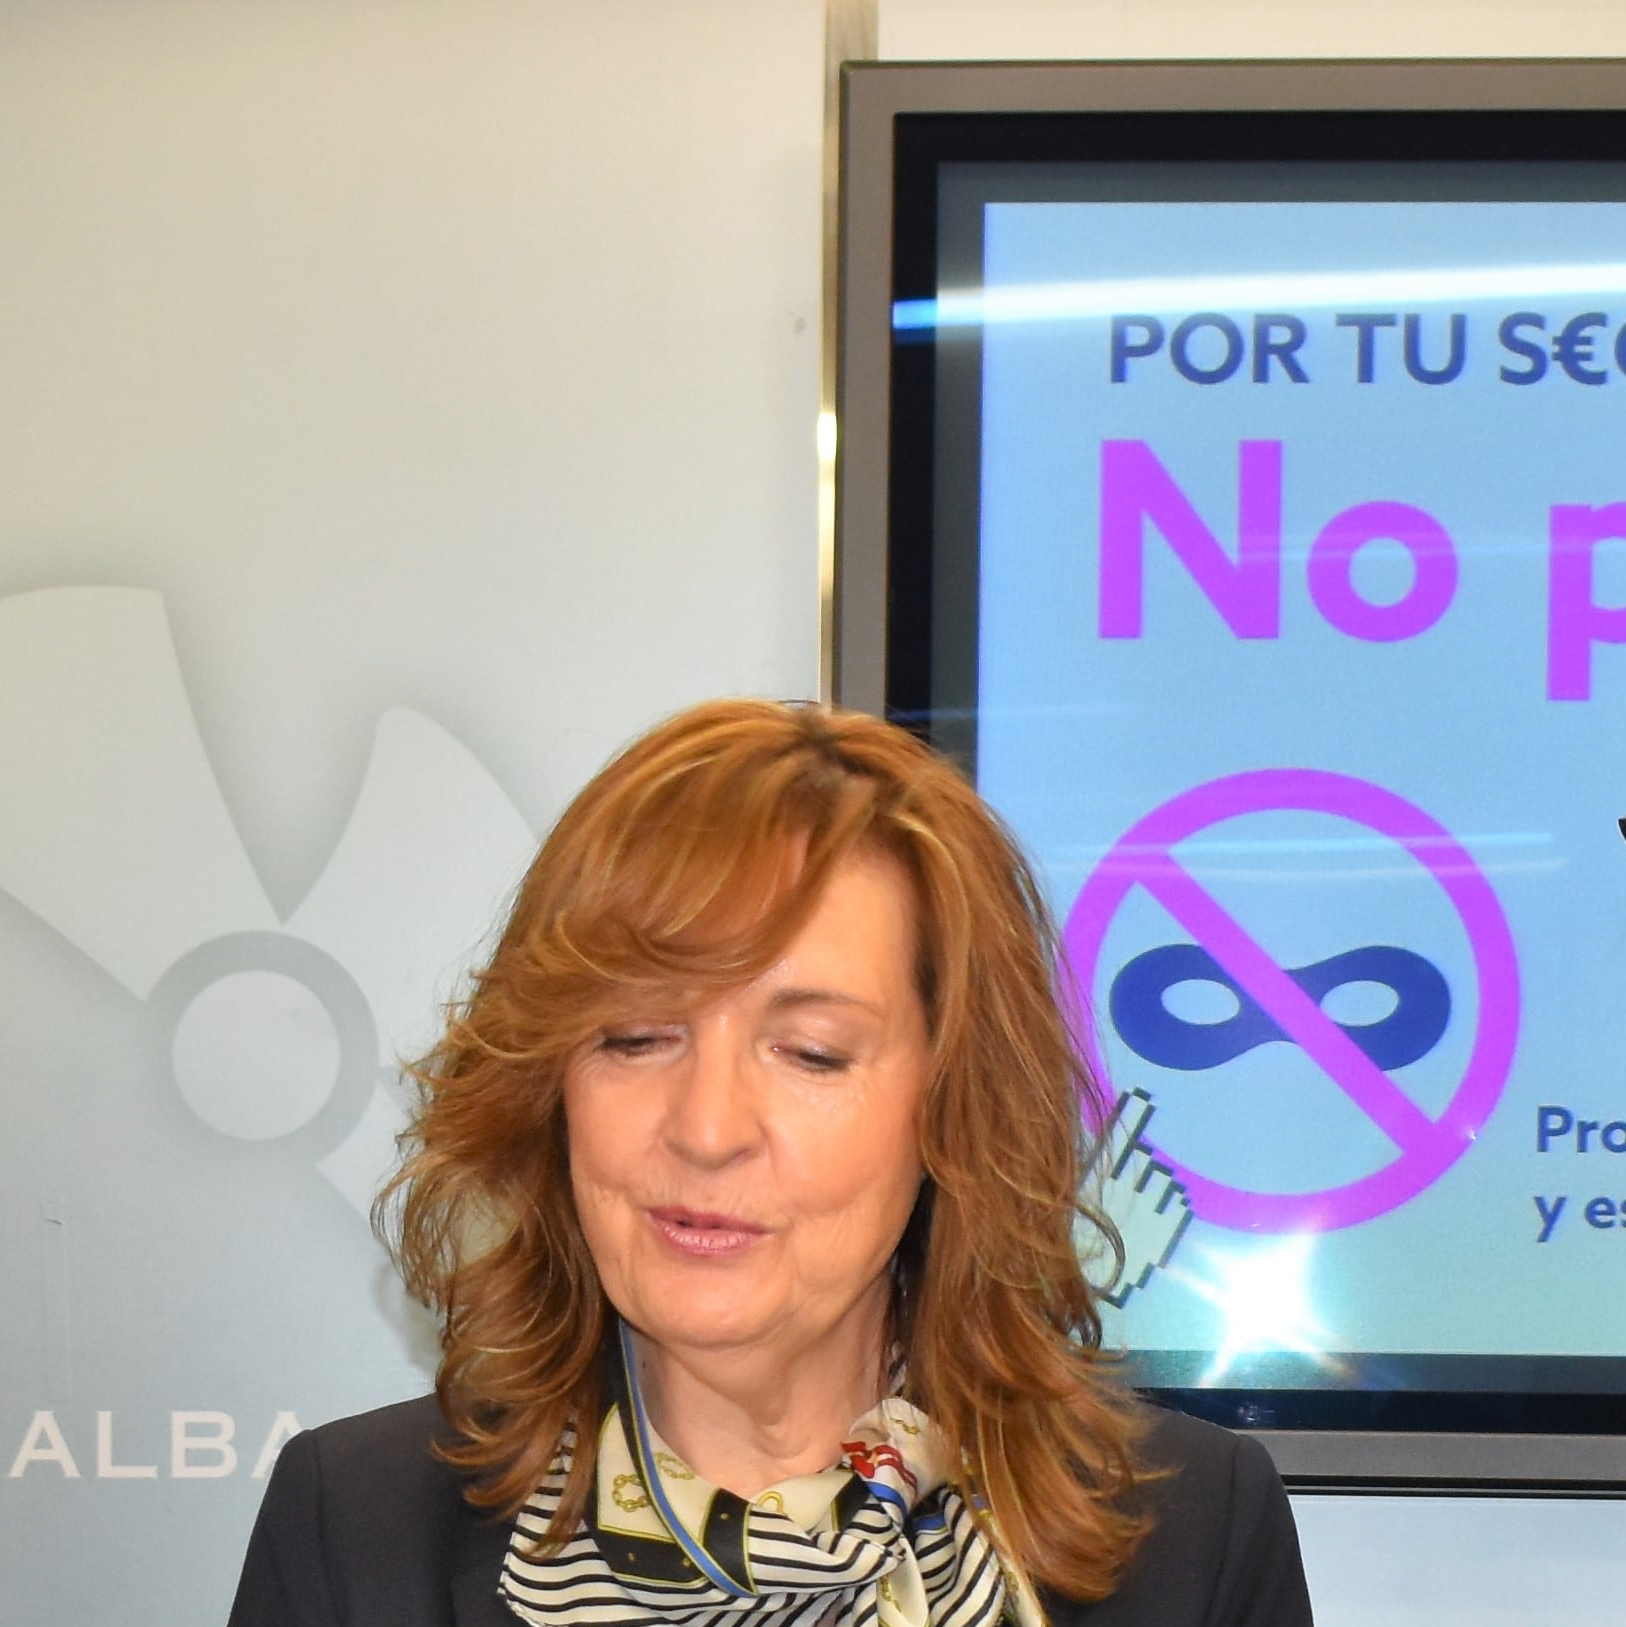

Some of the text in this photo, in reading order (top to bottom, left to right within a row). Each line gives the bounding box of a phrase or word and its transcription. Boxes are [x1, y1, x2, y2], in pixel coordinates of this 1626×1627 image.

[1110, 312, 1307, 385] POR
[1337, 312, 1469, 386] TU
[1097, 438, 1459, 645] No
[1533, 1195, 1568, 1243] y
